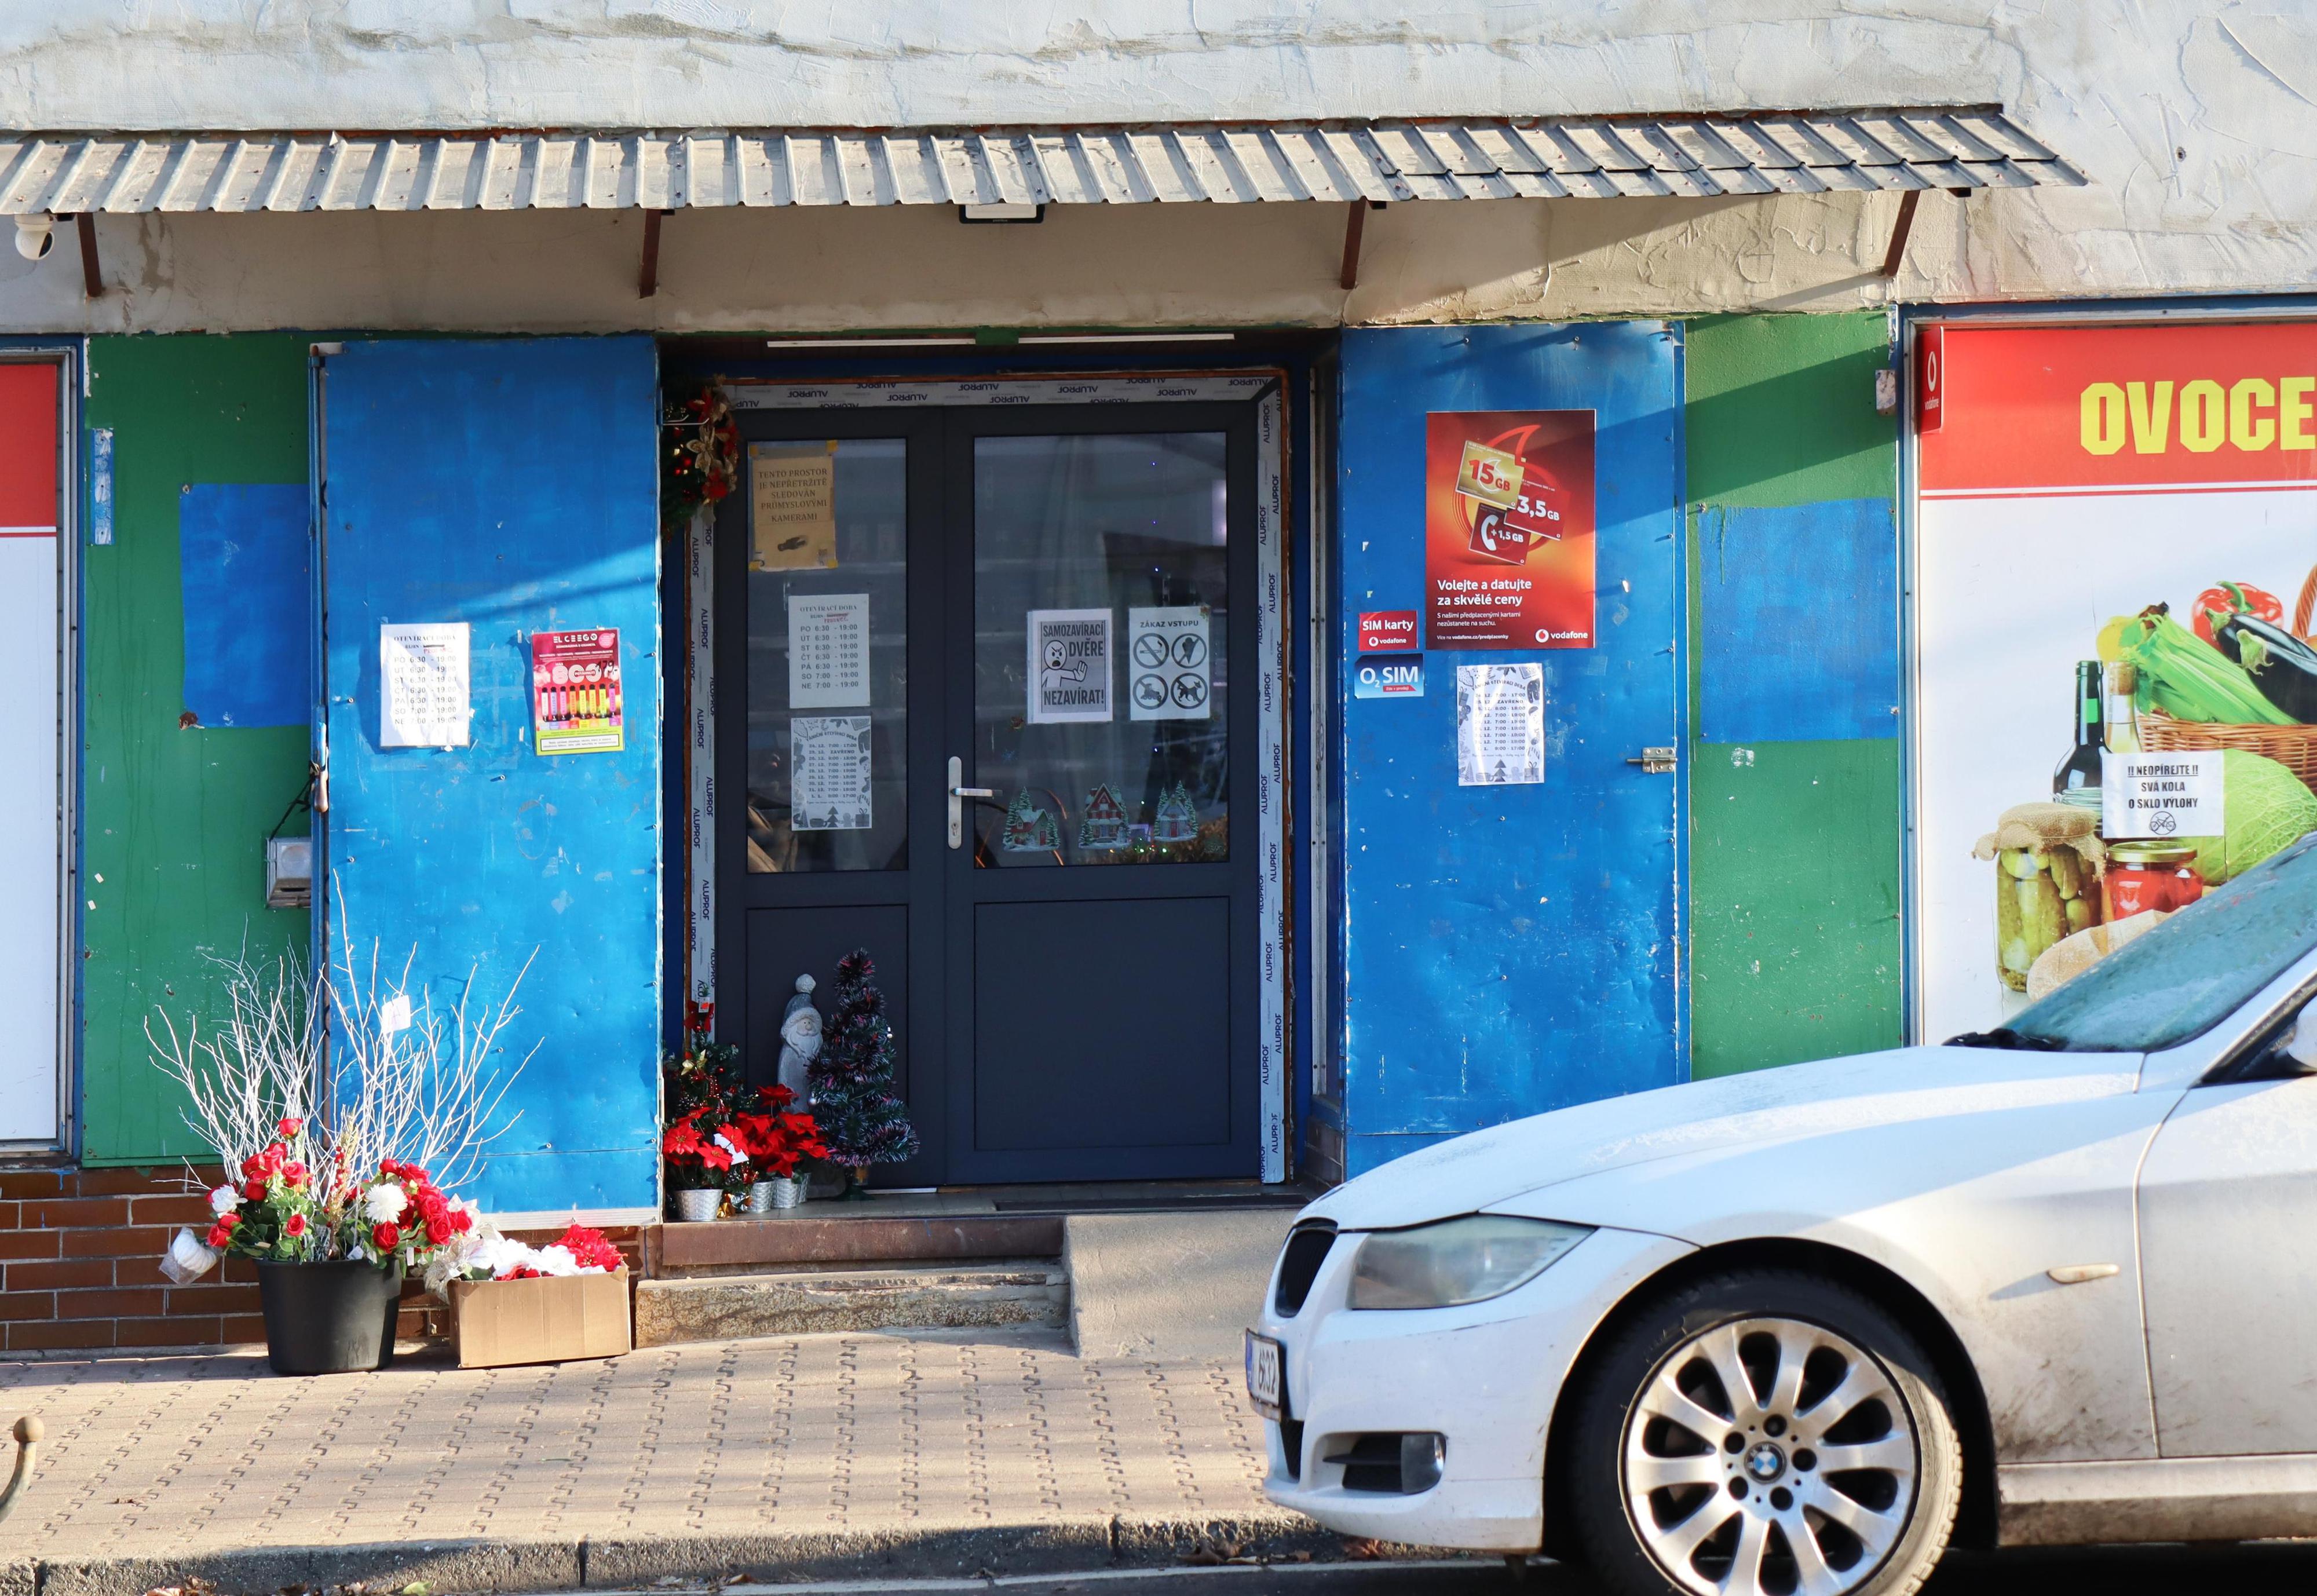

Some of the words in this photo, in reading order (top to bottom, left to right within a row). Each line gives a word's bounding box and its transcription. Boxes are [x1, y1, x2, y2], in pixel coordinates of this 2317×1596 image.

[989, 395, 1030, 403] ALUPROF
[1924, 396, 1939, 411] vodafone
[2080, 377, 2315, 456] OVOCE
[758, 470, 787, 479] TENTO
[789, 468, 828, 477] PROSTOR
[759, 481, 768, 490] JE
[771, 513, 818, 523] KAMERAMI
[1437, 579, 1478, 593] Volejte
[1481, 581, 1488, 590] a
[1490, 579, 1532, 592] datujte
[1437, 597, 1451, 605] za
[1454, 593, 1492, 605] skvělé
[1494, 596, 1523, 607] ceny
[1460, 611, 1500, 619] předplacenými
[1043, 622, 1103, 637] SAMOZAVÍRACÍ
[1168, 620, 1199, 628] VSTUPU
[1362, 620, 1382, 631] SIM
[1384, 619, 1414, 631] karty
[1550, 630, 1588, 639] vodafone
[801, 652, 811, 660] ČT
[1382, 666, 1419, 684] SIM
[1044, 686, 1104, 705] NEZAVÍRAT!
[2136, 763, 2190, 776] NEOPÍREJTE
[2141, 780, 2159, 792] SVÁ
[2162, 781, 2186, 792] KOLA
[2128, 799, 2135, 809] O
[2137, 798, 2161, 809] SKLO
[2163, 796, 2198, 808] VÝLOHY
